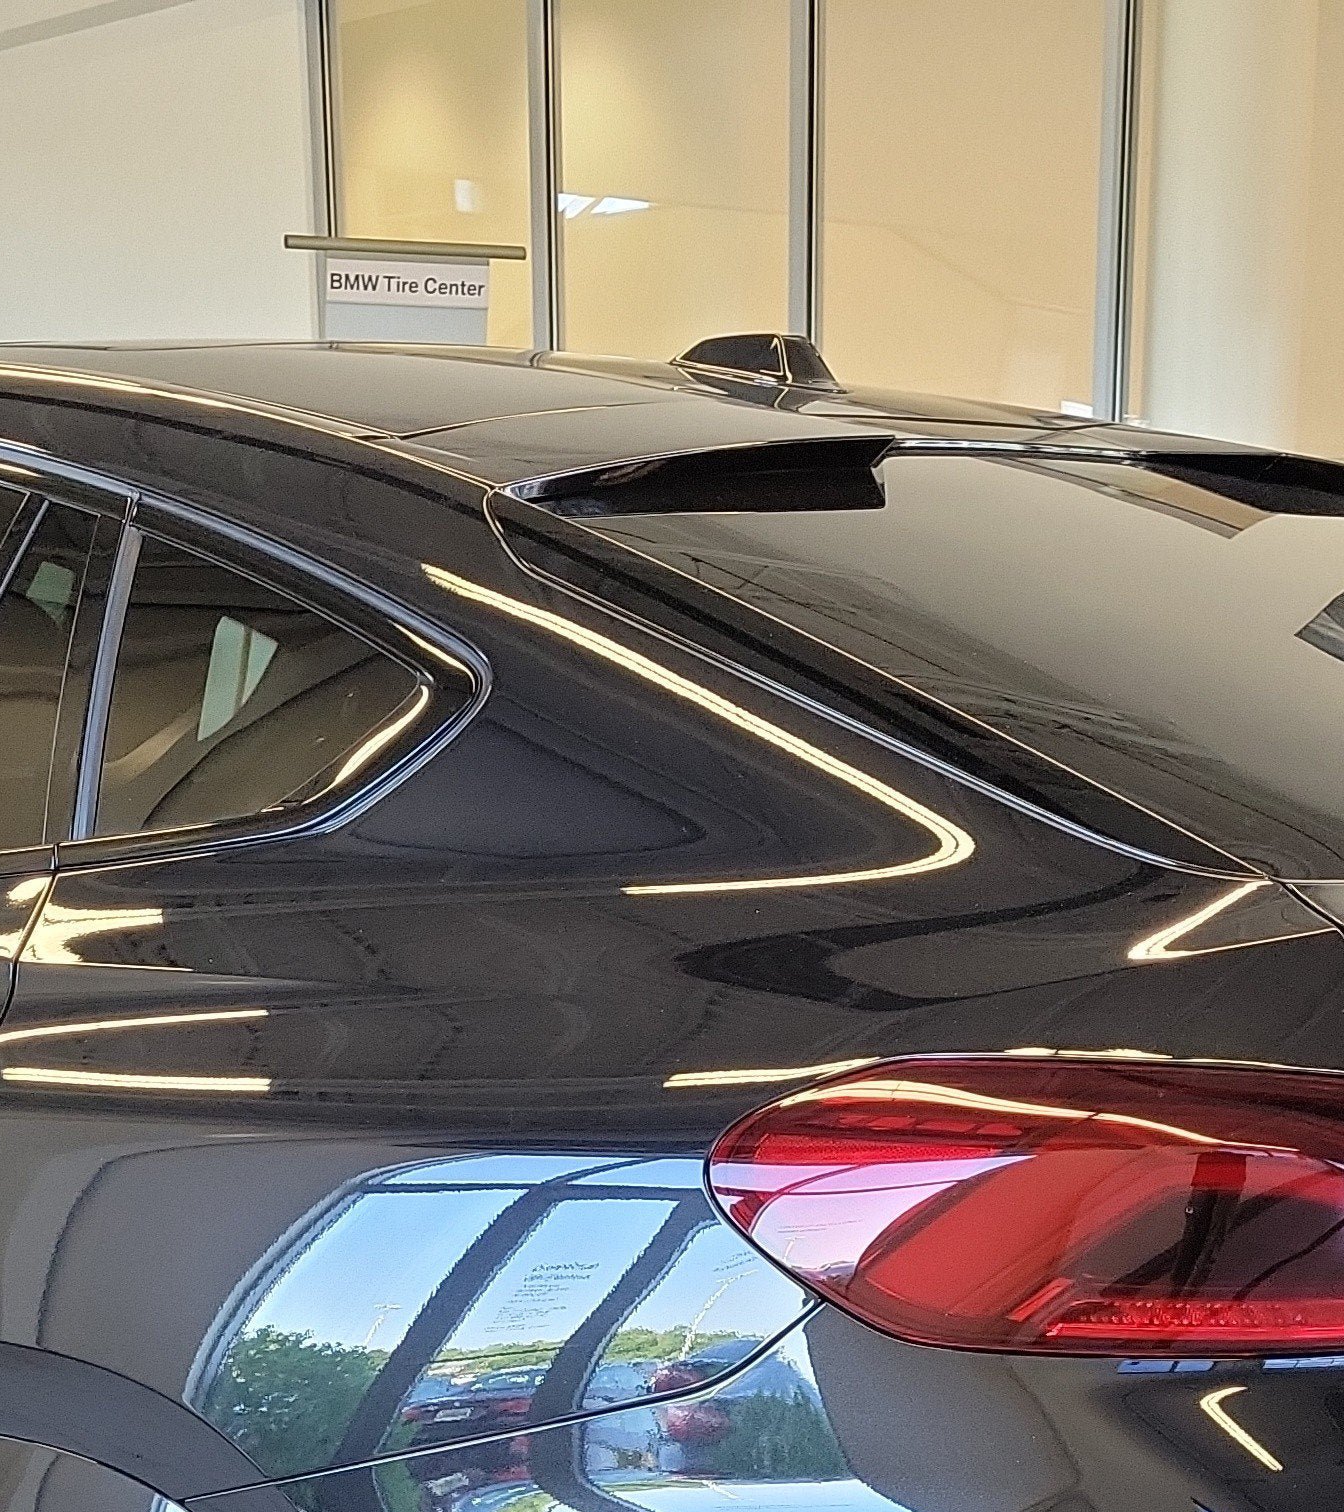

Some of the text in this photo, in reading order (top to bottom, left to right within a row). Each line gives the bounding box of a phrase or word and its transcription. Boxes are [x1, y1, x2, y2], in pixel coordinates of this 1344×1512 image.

[330, 273, 485, 297] BMW Tire Center
